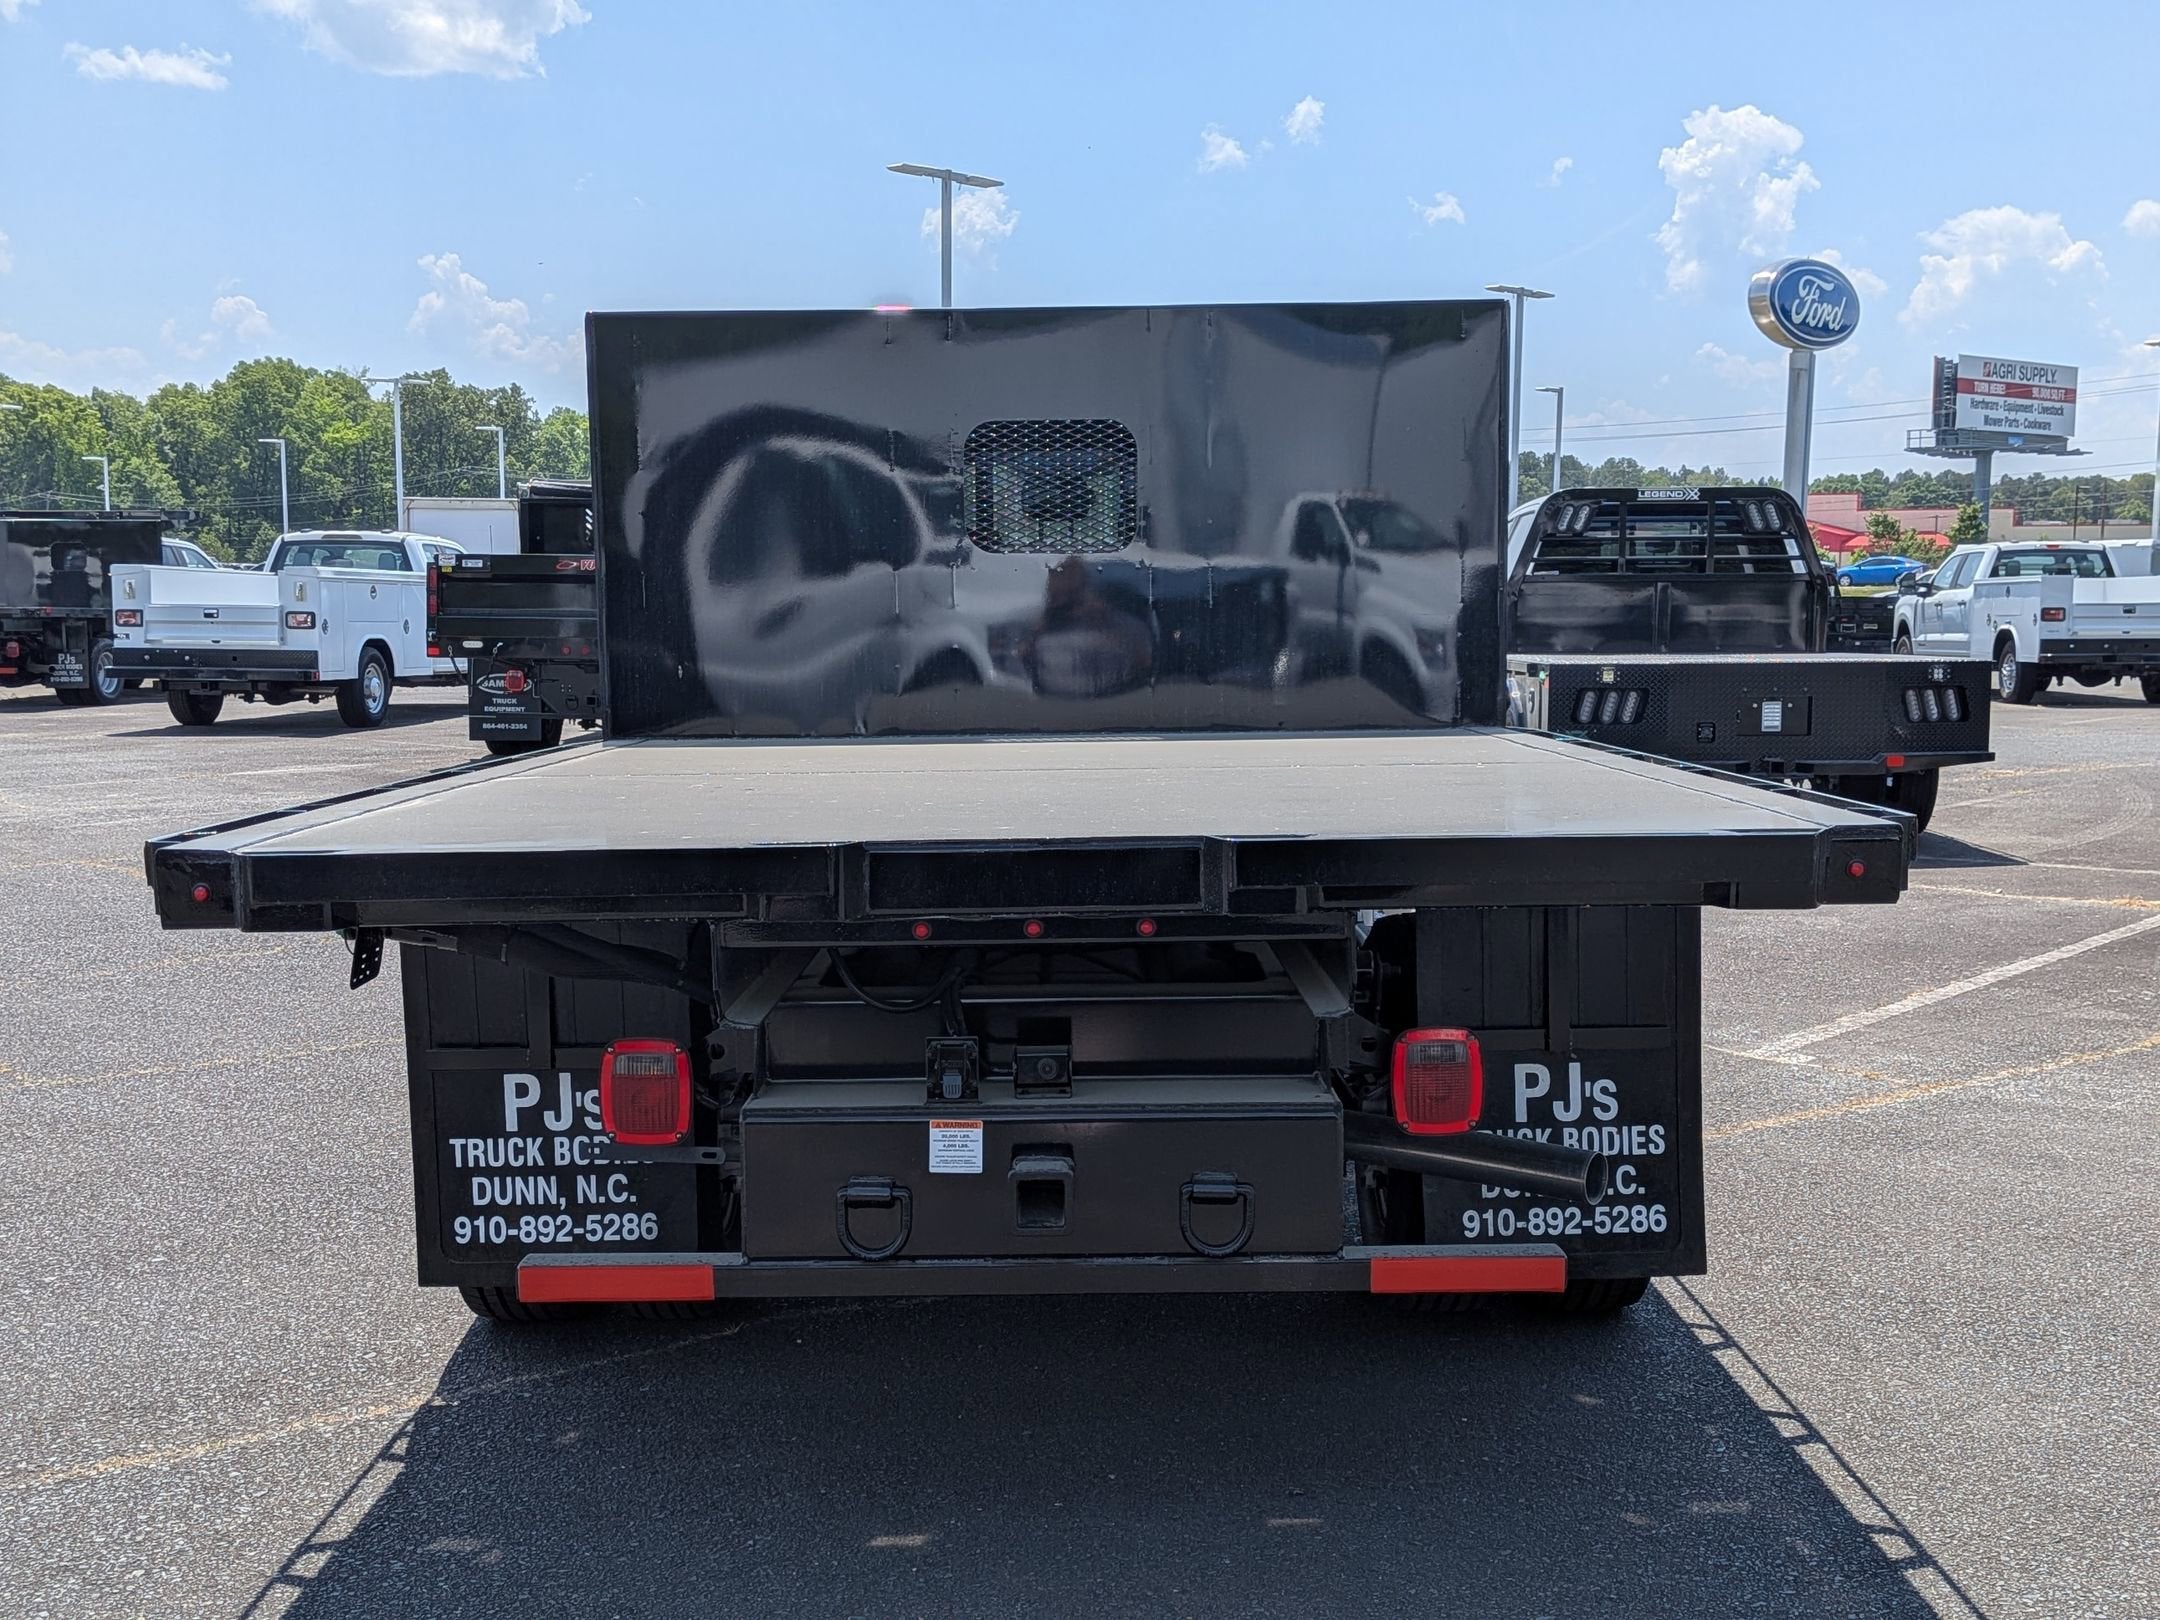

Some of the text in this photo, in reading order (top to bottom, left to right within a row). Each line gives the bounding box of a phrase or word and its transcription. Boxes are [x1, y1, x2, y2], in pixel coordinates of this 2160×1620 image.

[1791, 275, 1847, 331] Ford
[1992, 363, 2057, 383] AGRI SUPPLY
[1970, 398, 2065, 416] Hardware Equipment Livestock
[1983, 415, 2052, 431] Mower Parts Cookware
[1638, 490, 1683, 498] LEGEND
[449, 1137, 544, 1168] TRUCK
[1563, 1125, 1666, 1156] BODIES
[471, 1173, 637, 1210] DUNN, N.C.
[453, 1212, 659, 1244] 910-892-5286
[1462, 1204, 1668, 1238] 910-892-5286
